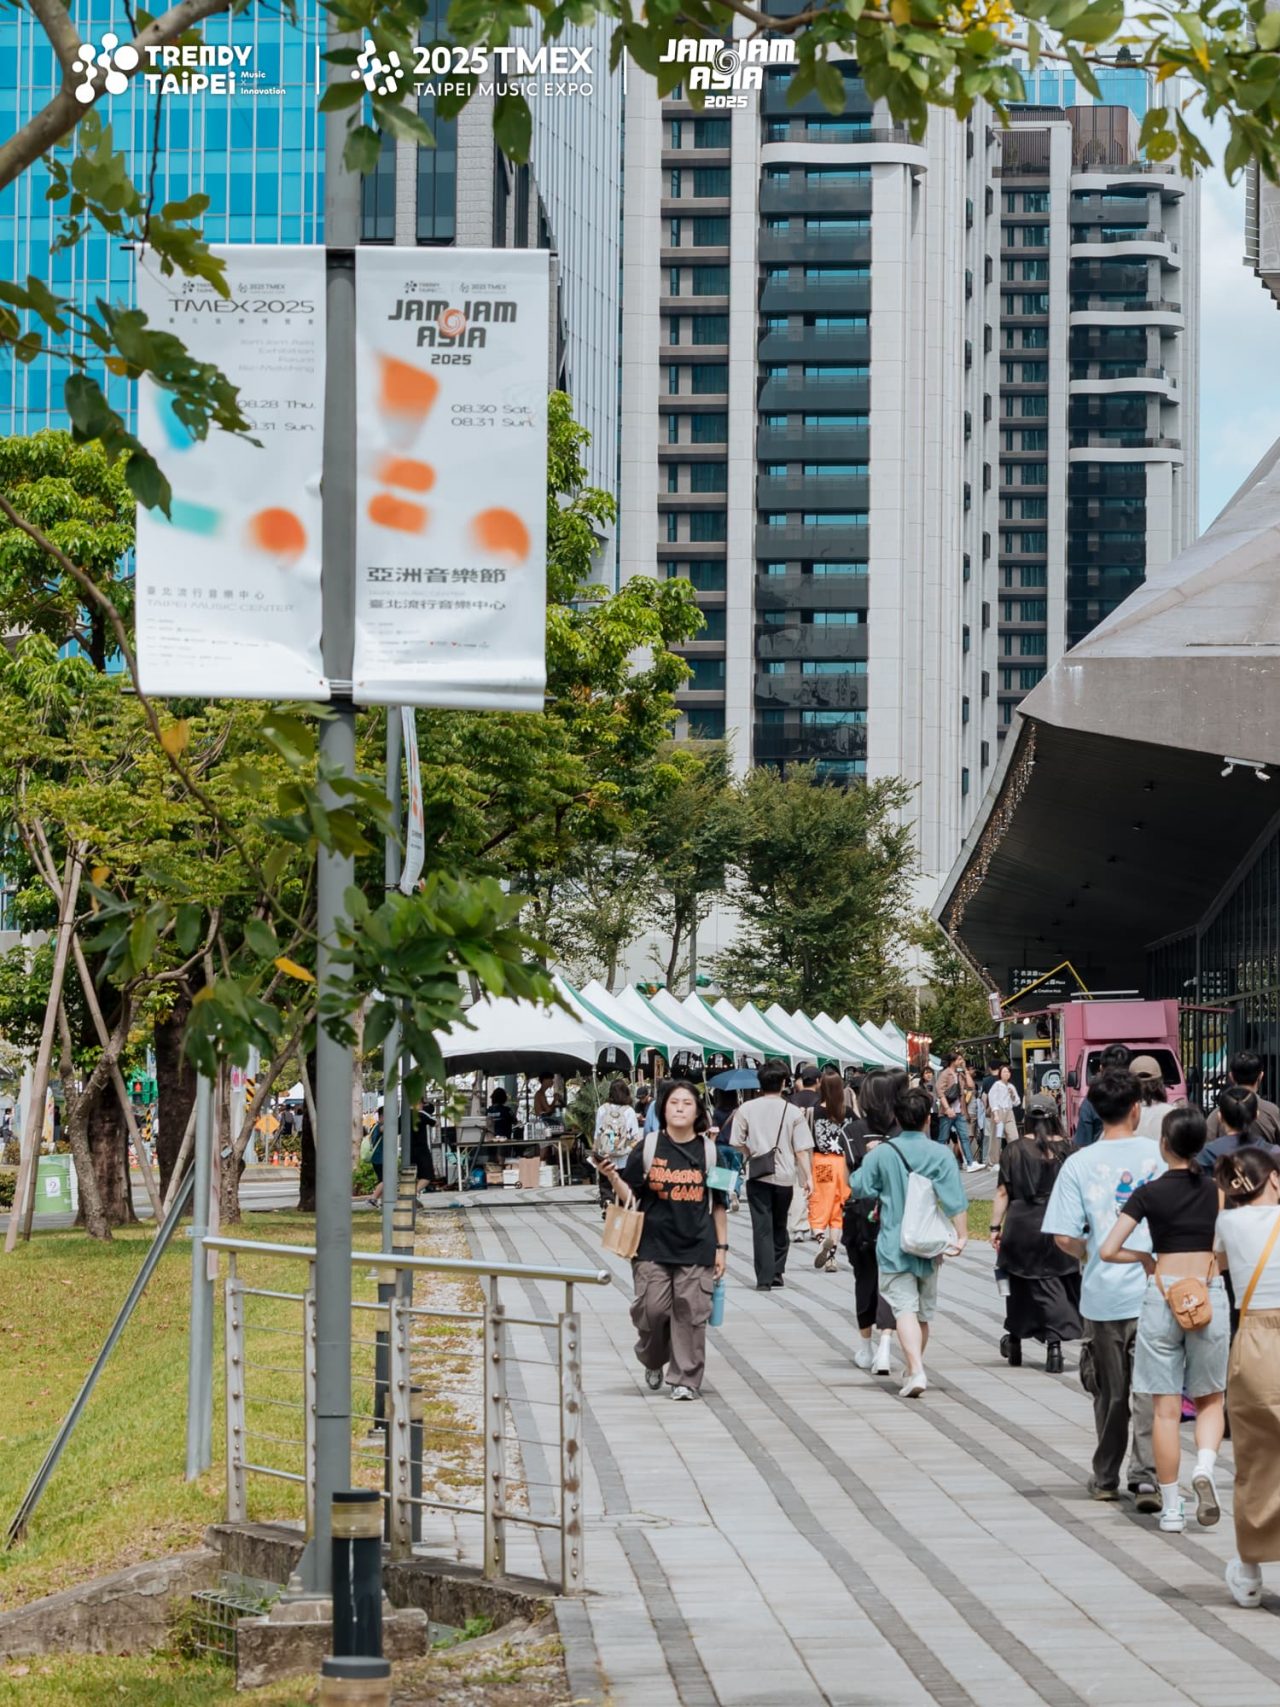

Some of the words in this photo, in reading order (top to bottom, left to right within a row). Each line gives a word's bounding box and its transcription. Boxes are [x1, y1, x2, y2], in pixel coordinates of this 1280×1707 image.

[388, 299, 450, 321] JAM
[416, 326, 487, 348] ASIA
[431, 354, 472, 365] 2025
[451, 404, 497, 413] 08.30
[451, 417, 495, 427] 08.31
[367, 567, 506, 584] 亞洲音樂節
[369, 599, 506, 611] 臺北流行音樂中心
